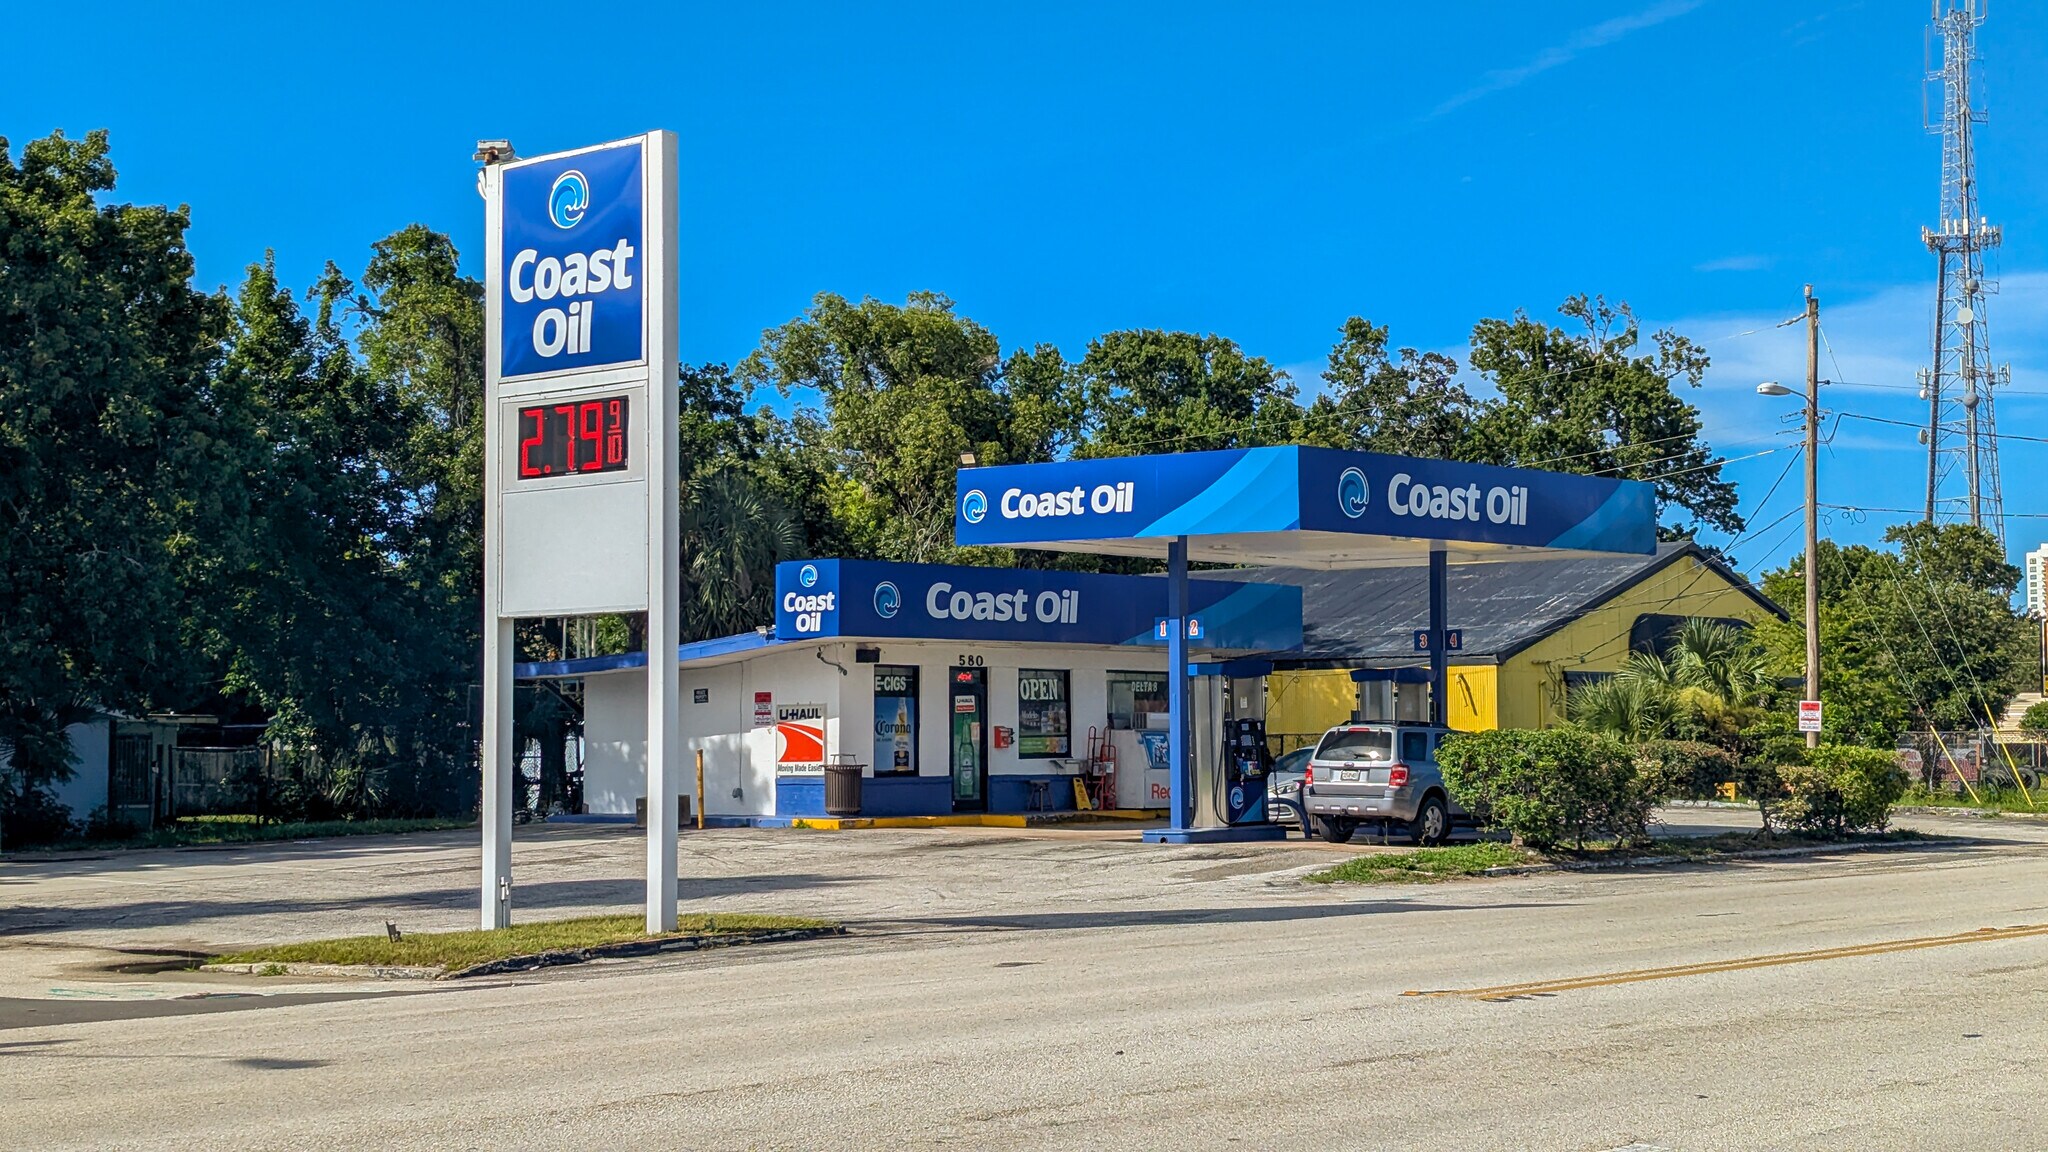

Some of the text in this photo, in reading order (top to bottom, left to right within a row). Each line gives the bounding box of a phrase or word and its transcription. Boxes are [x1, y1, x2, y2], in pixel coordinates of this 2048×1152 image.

[509, 238, 634, 304] Coast
[532, 300, 593, 358] Oil
[1000, 481, 1134, 520] Coast Oil
[1386, 473, 1528, 527] Coast Oil
[783, 591, 835, 613] Coast
[926, 581, 1079, 625] Coast Oil
[795, 613, 821, 633] Oil
[1160, 620, 1167, 637] 1
[1189, 619, 1198, 636] 2
[1419, 634, 1428, 649] 3
[1449, 634, 1458, 648] 4
[959, 654, 984, 667] 580
[874, 675, 906, 692] E-CIGS
[1020, 678, 1058, 700] OPEN
[1131, 681, 1153, 692] DELTA
[779, 708, 821, 720] U-HAUL
[875, 720, 911, 736] Corona
